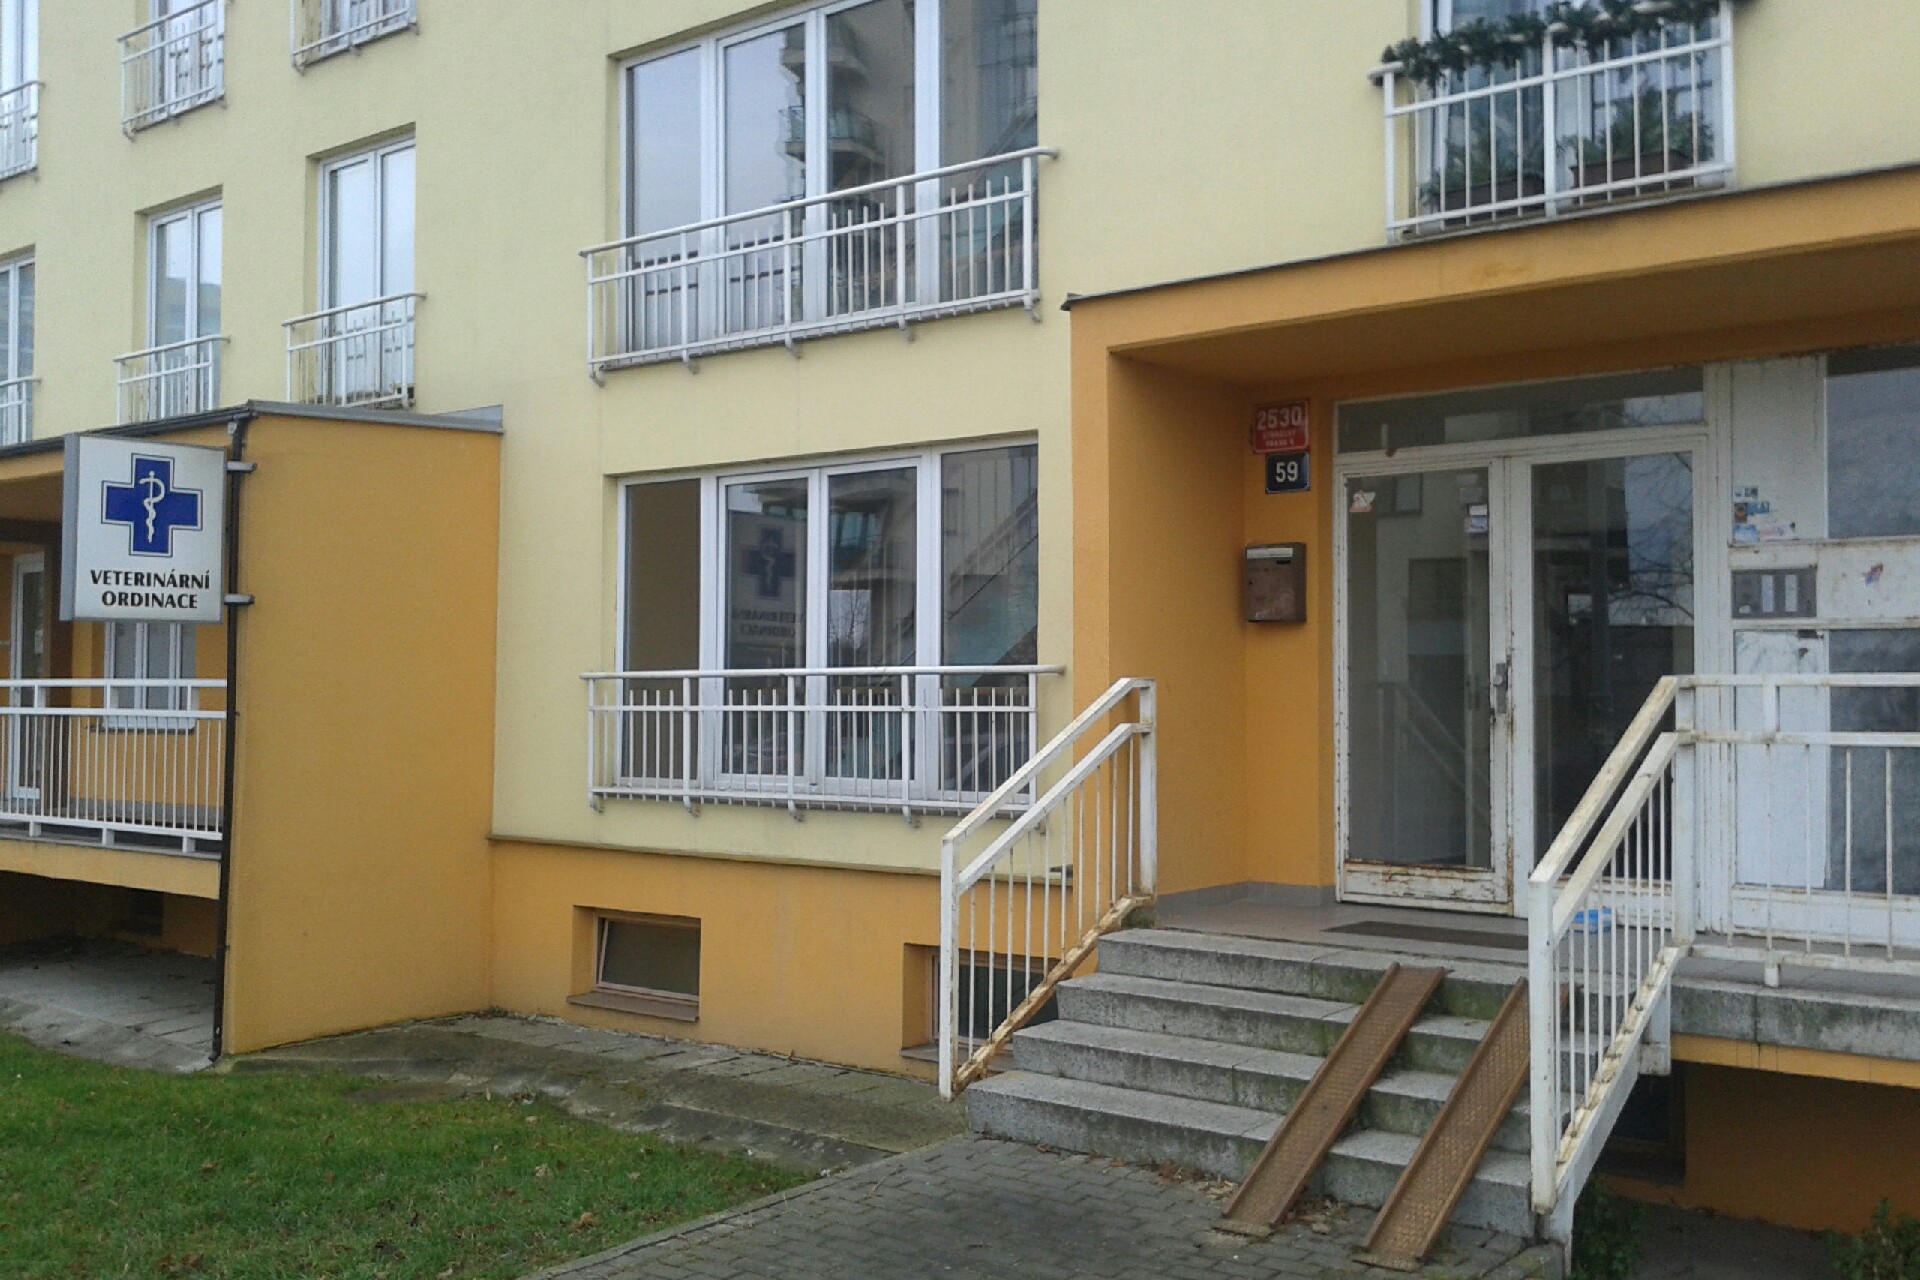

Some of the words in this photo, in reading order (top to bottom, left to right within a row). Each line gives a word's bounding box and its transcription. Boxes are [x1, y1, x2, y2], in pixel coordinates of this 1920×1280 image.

[1257, 406, 1302, 431] 2530
[1276, 461, 1298, 482] 59
[90, 569, 210, 589] VETERINÁRNÍ
[102, 591, 198, 608] ORDINACE
